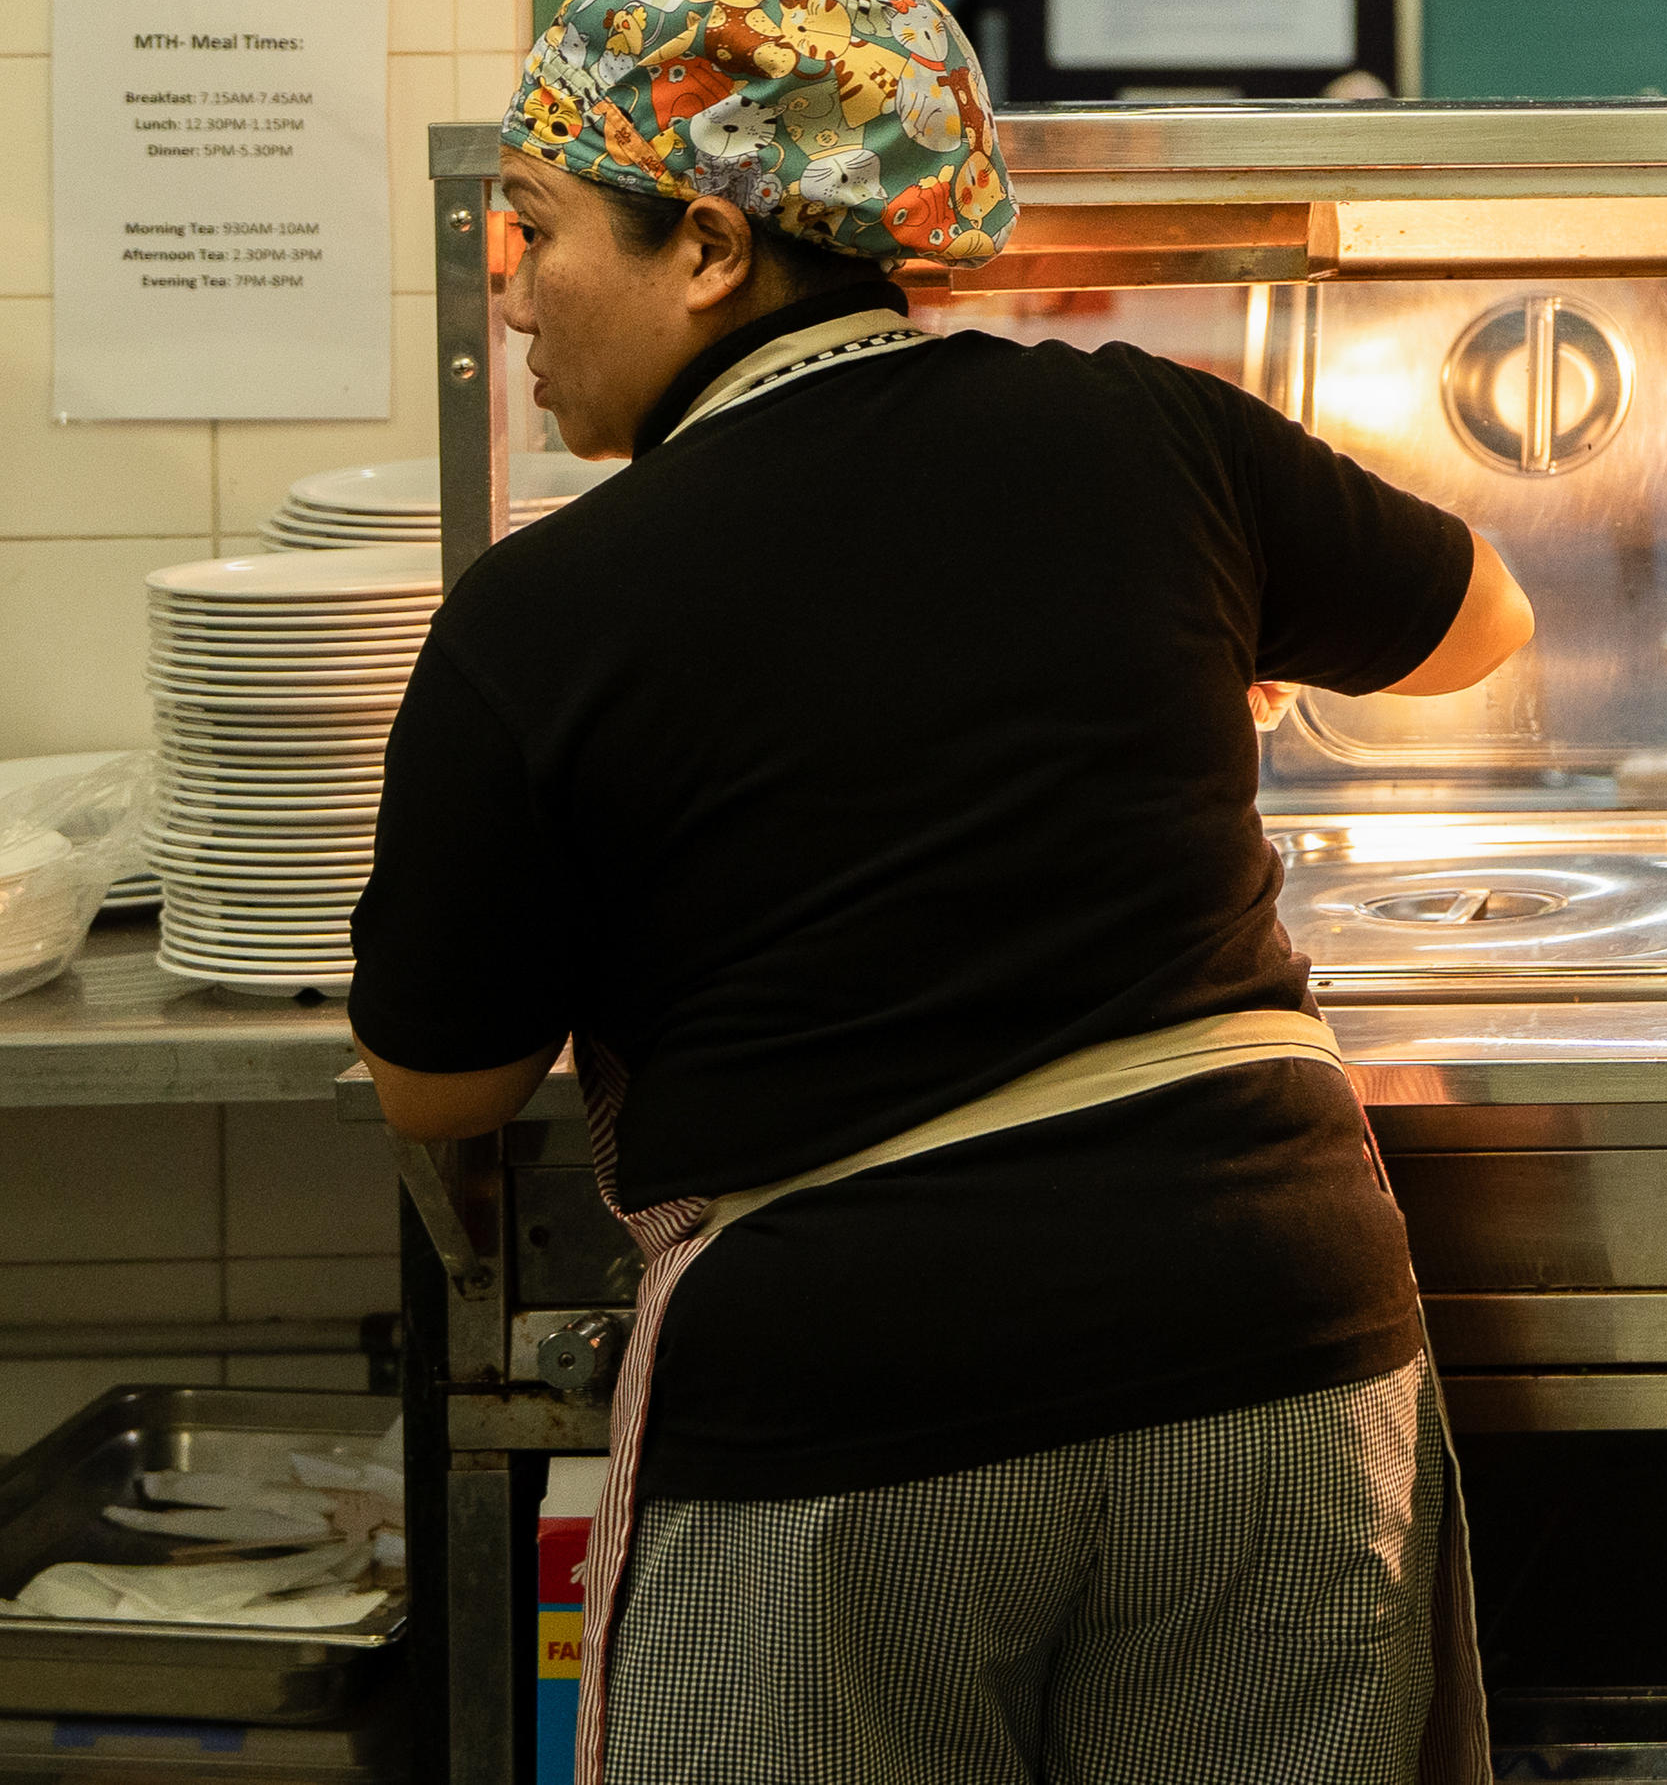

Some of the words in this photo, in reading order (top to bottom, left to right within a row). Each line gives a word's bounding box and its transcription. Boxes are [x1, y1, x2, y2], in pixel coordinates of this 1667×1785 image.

[134, 34, 185, 50] MTH-
[191, 34, 238, 50] Meal
[243, 34, 304, 50] Times:
[125, 91, 196, 104] Breakfast:
[200, 91, 313, 104] 7.15AM-7.45AM
[135, 117, 180, 130] Lunch:
[185, 118, 304, 131] 12.30PM-1.15PM
[148, 144, 199, 157] Dinner:
[204, 145, 293, 157] 5PM-5.30PM
[125, 222, 185, 237] Morning
[189, 222, 219, 235] Tea:
[122, 249, 195, 261] Afternoon
[199, 249, 229, 261] Tea:
[142, 274, 198, 289] Evening
[201, 275, 231, 287] Tea:
[234, 275, 304, 287] 7PM-8PM
